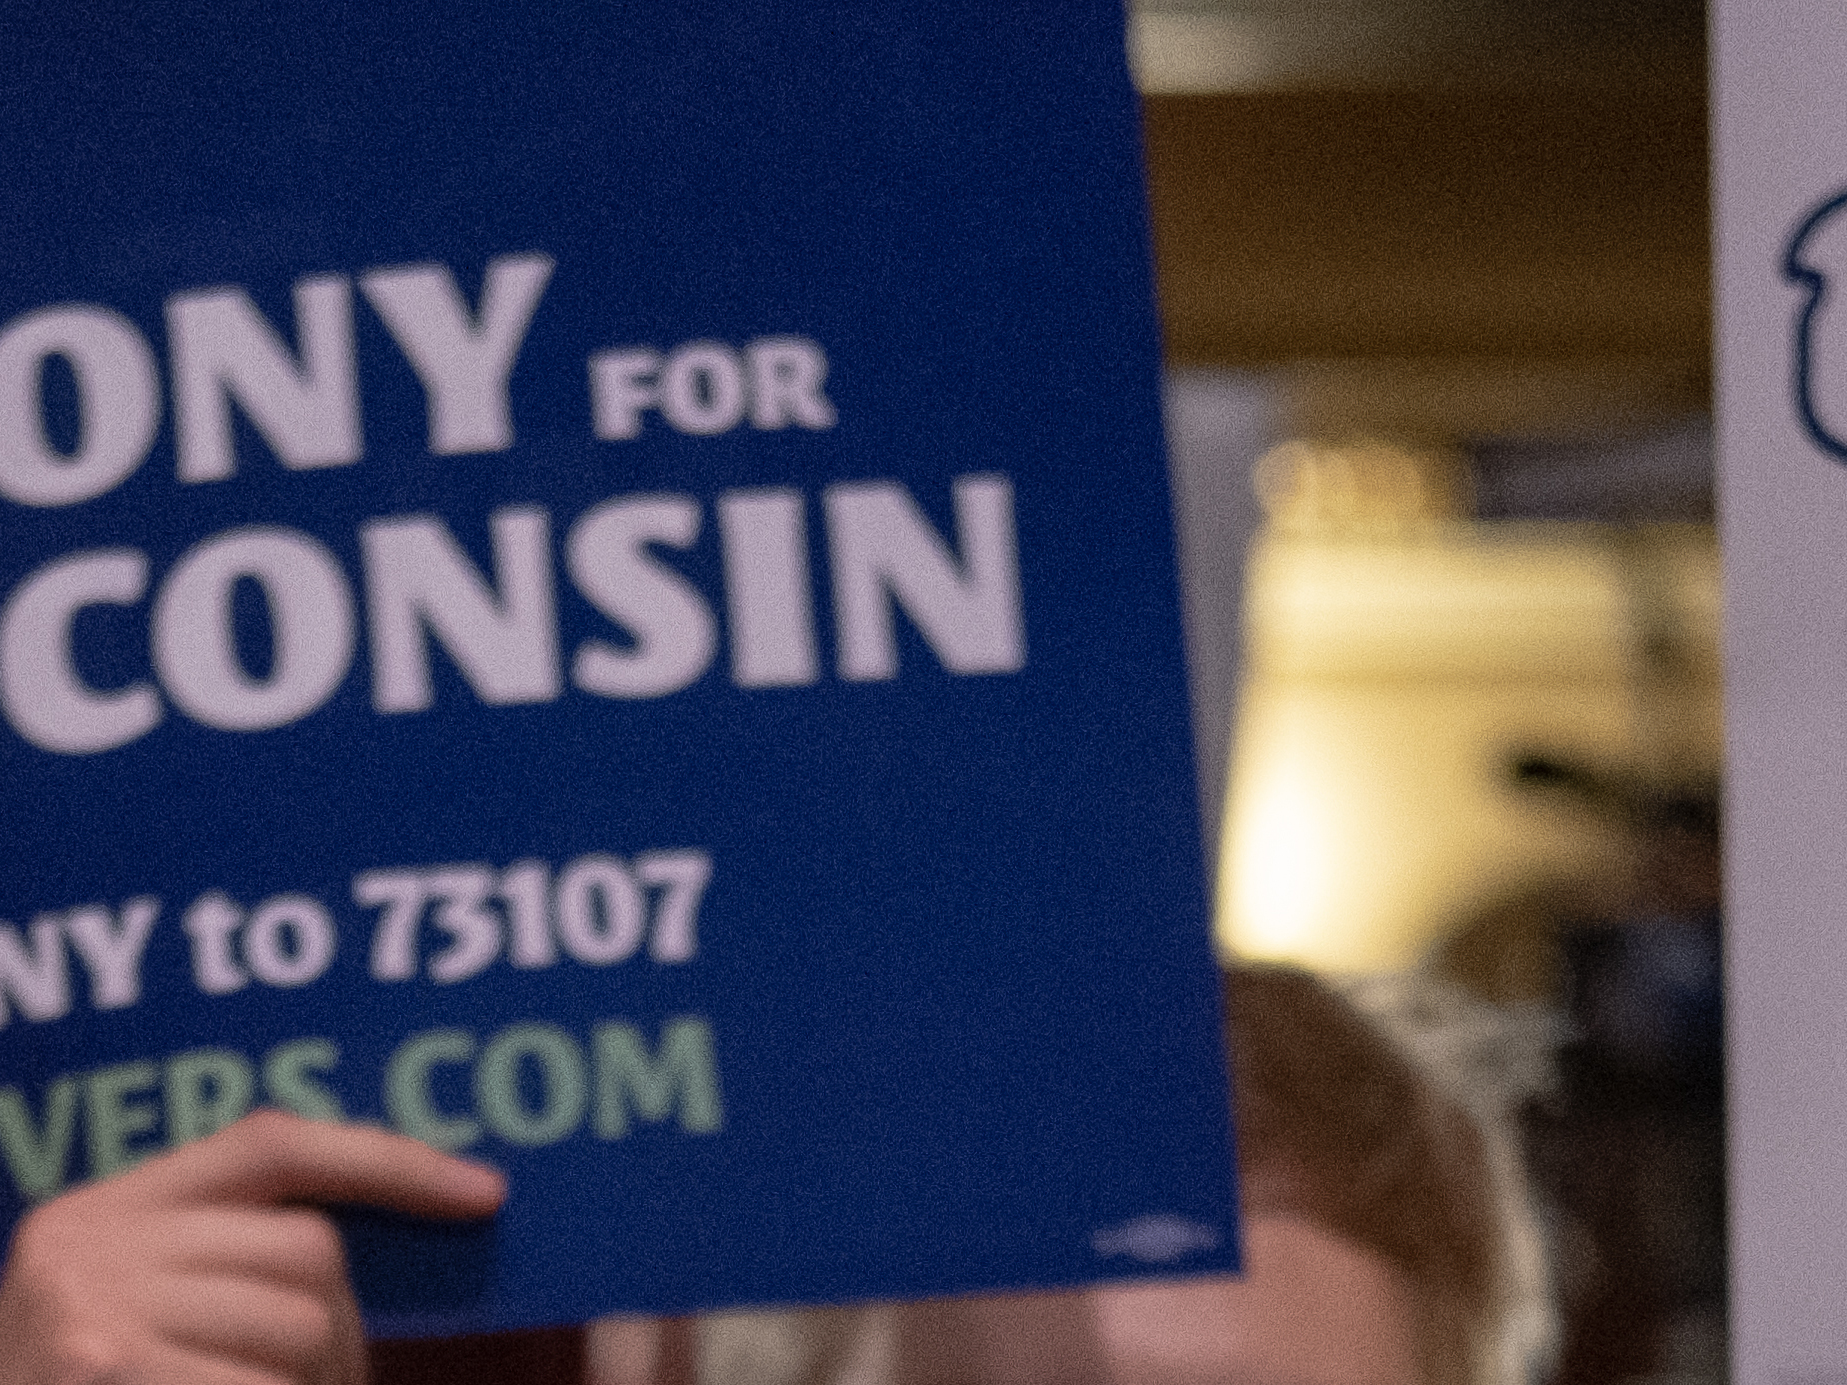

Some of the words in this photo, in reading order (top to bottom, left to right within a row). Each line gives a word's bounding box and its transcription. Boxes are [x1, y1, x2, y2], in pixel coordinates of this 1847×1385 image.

[588, 336, 835, 442] FOR
[183, 893, 336, 995] to
[352, 850, 712, 984] 73107
